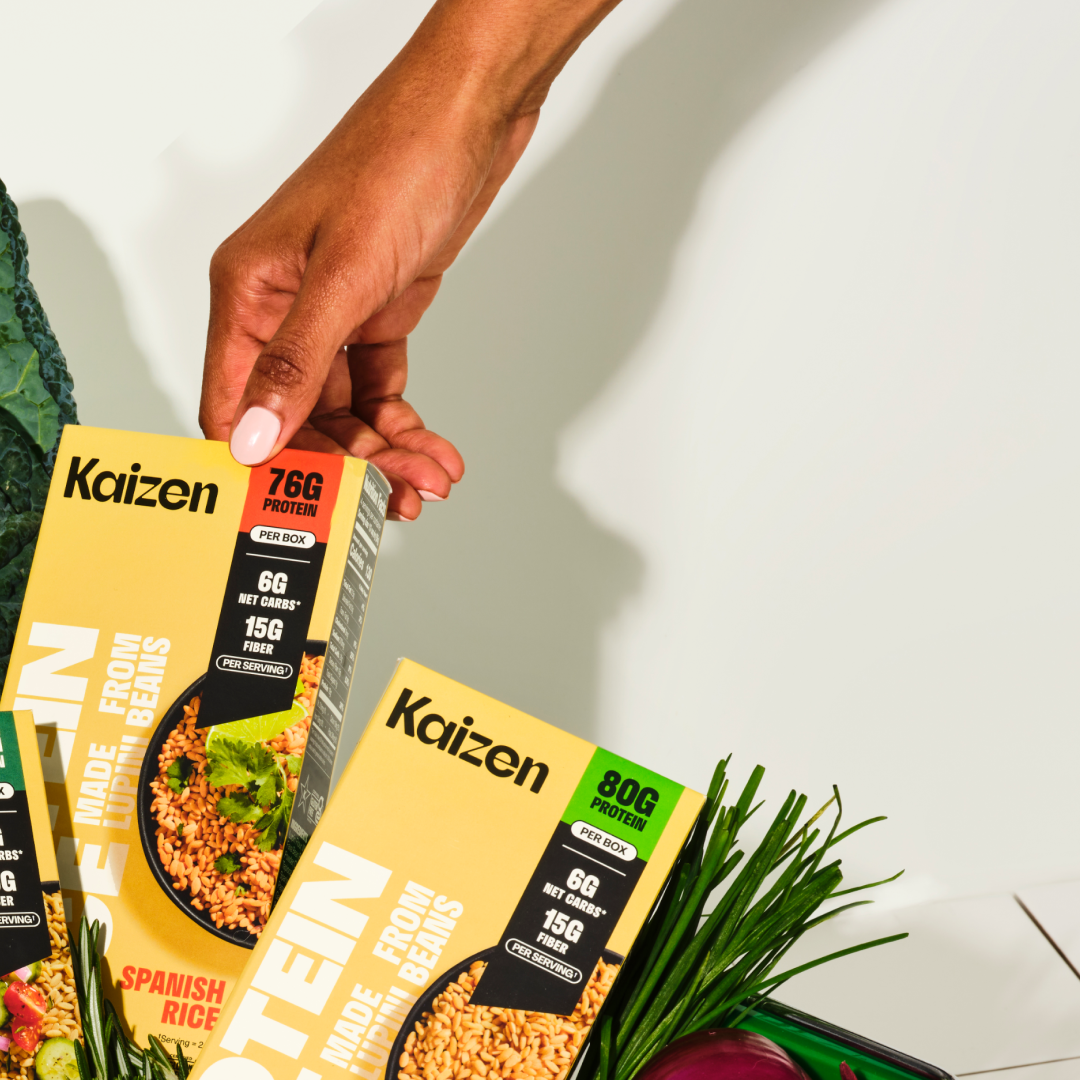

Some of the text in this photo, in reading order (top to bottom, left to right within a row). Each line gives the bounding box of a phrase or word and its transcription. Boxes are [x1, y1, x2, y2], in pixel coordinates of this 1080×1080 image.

[63, 456, 219, 515] Kaizen
[268, 467, 324, 501] 76G
[262, 497, 318, 517] PROTEIN
[259, 530, 306, 545] PER BOX
[257, 570, 288, 594] 6G
[238, 593, 259, 606] NET
[245, 615, 284, 641] 15G
[243, 640, 274, 655] FIBER
[222, 658, 241, 669] PER
[73, 743, 117, 826] MADE
[98, 632, 142, 715] FROM
[102, 636, 171, 830] LUPINI BEANS
[385, 687, 549, 794] Kaizen
[597, 770, 659, 818] 80G
[589, 796, 648, 832] PROTEIN
[580, 827, 628, 856] PER BOX
[542, 882, 566, 900] NET
[566, 868, 600, 899] 6G
[397, 894, 464, 988] BEANS
[542, 908, 584, 944] 15G
[511, 942, 532, 958] PER
[536, 931, 569, 955] FIBER
[120, 965, 226, 1004] SPANISH
[320, 880, 436, 1066] MADE FROM
[160, 999, 221, 1031] RICE
